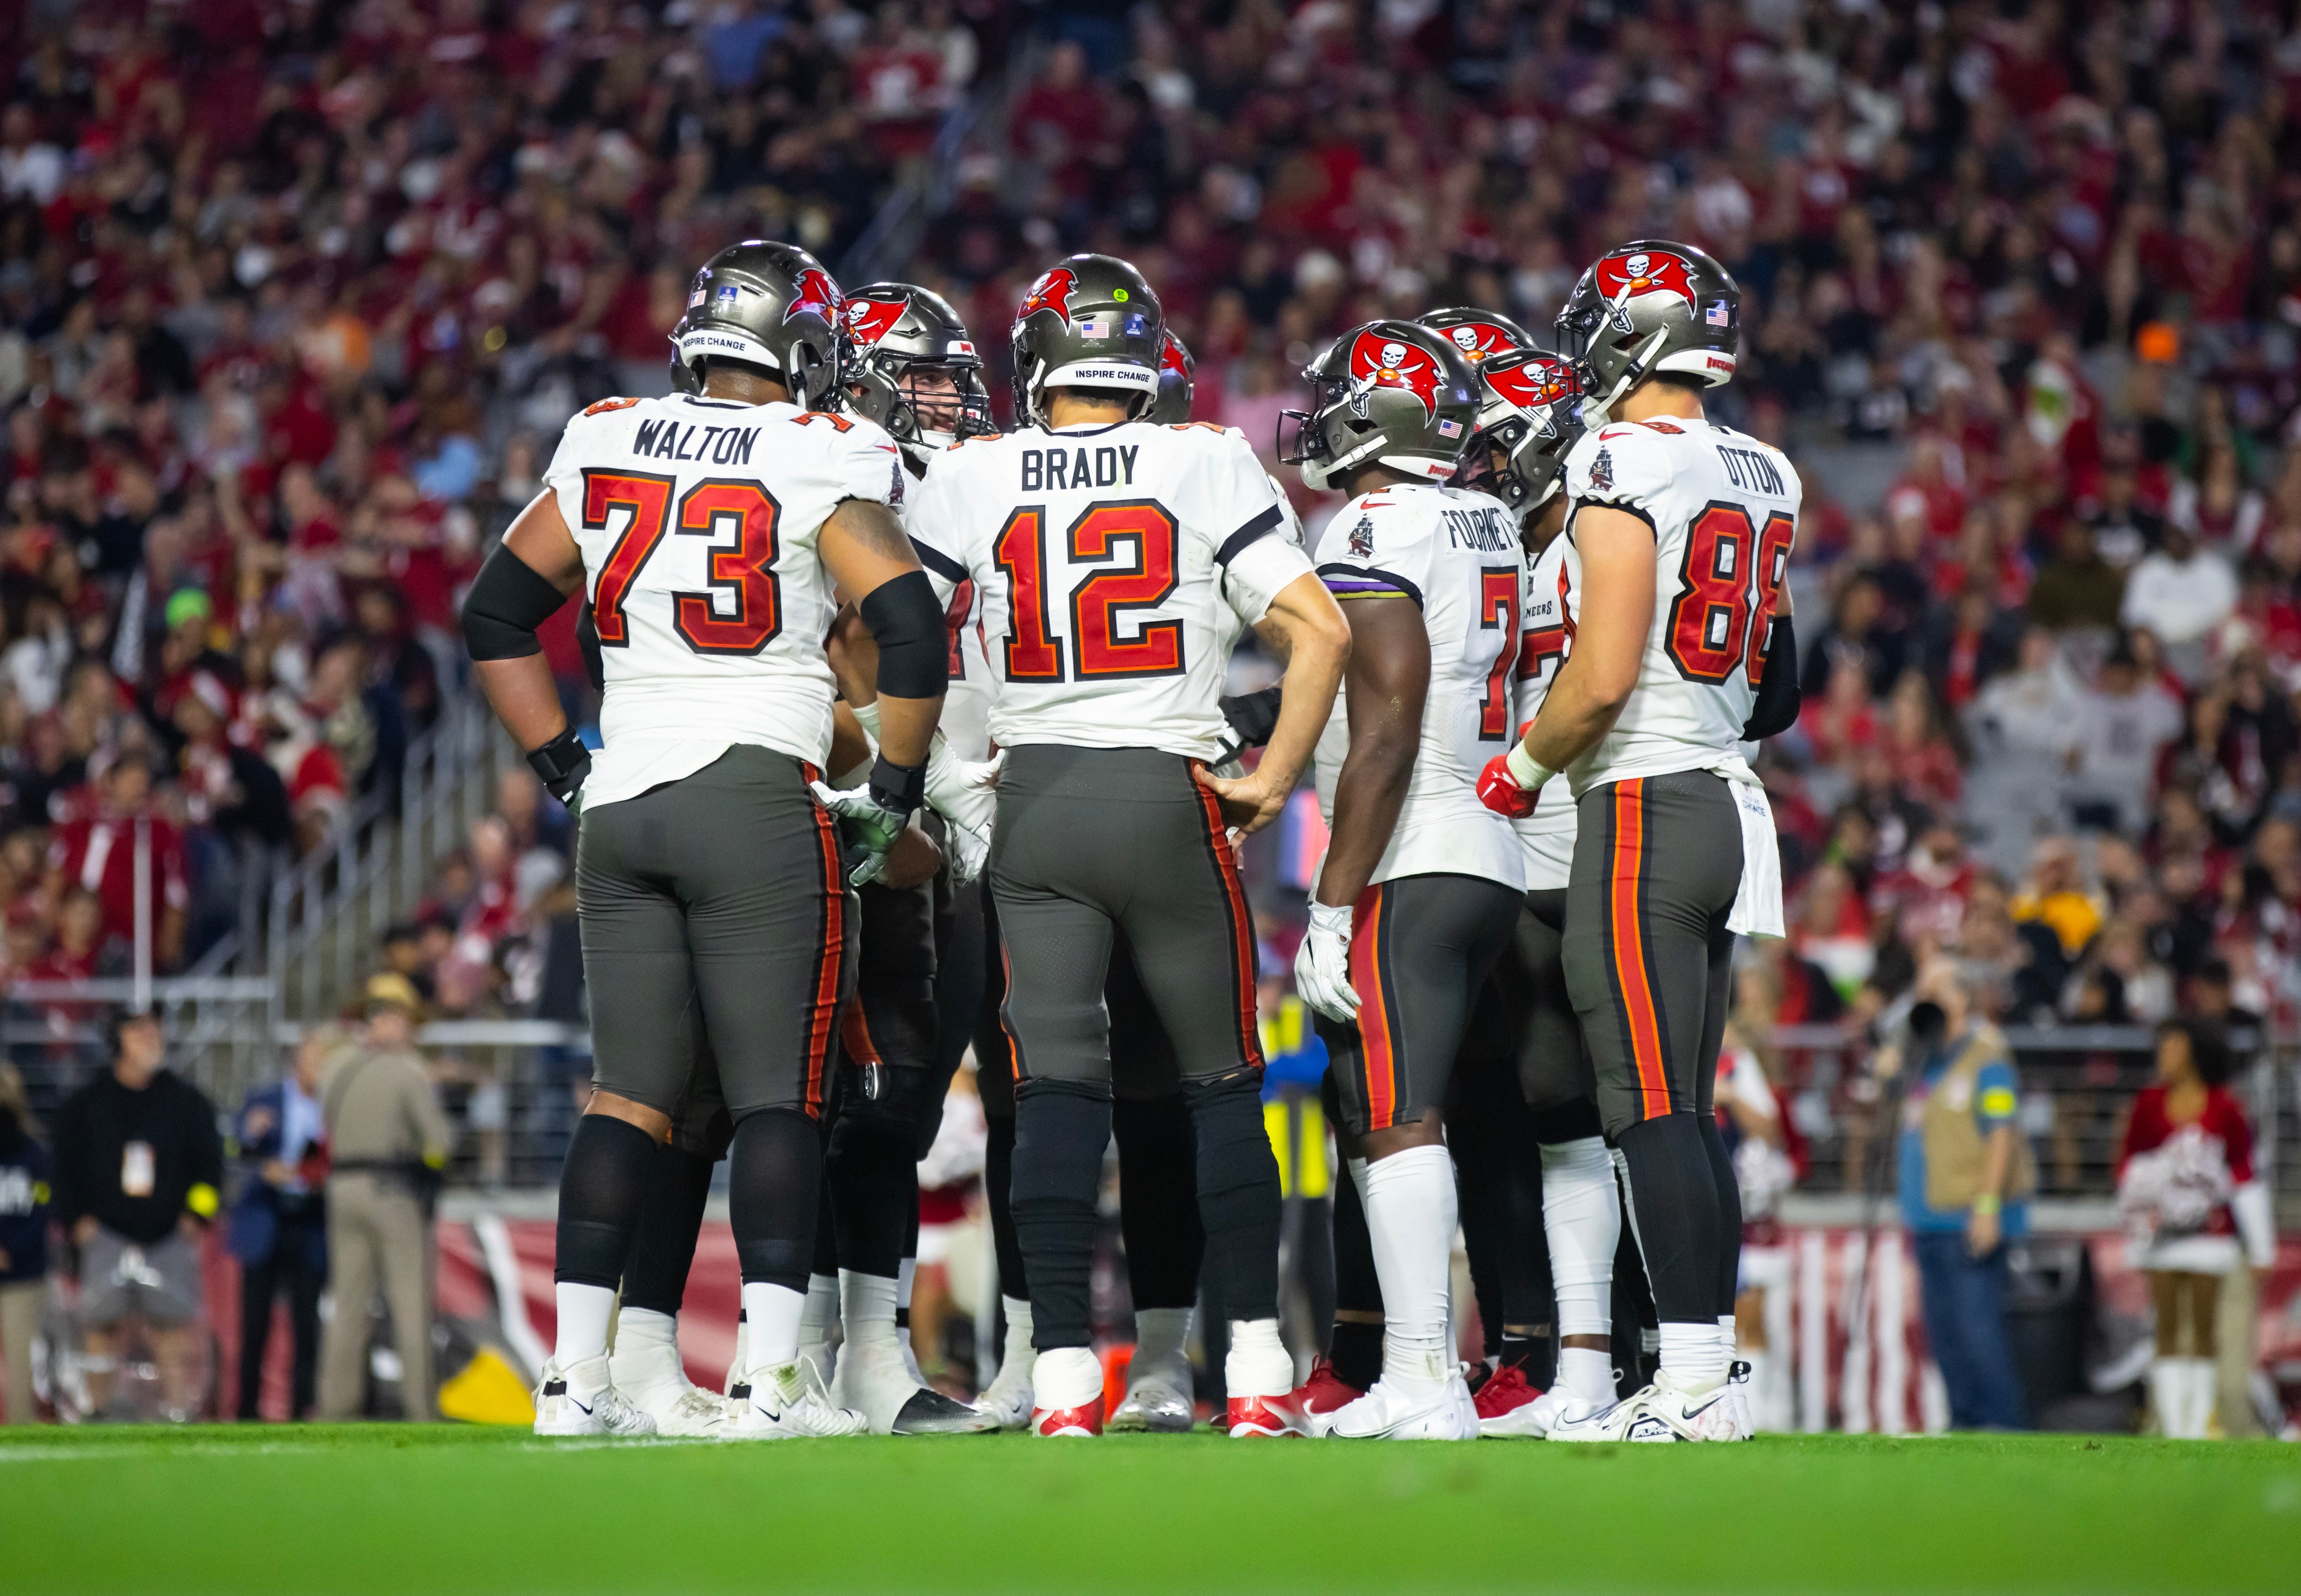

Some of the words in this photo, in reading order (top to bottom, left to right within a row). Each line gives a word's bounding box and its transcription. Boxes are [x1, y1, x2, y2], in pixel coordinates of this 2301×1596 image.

[682, 337, 705, 349] INSPIRE
[708, 338, 746, 351] CHANGE
[1076, 370, 1115, 378] INSPIRE
[1118, 371, 1150, 383] CHANGE
[633, 418, 763, 465] WALTON
[1021, 445, 1139, 492] BRADY
[1716, 444, 1785, 496] OTTON
[580, 467, 782, 656] 73
[992, 498, 1186, 683] 12
[1525, 601, 1552, 619] NEERS
[1663, 499, 1794, 692] 88
[1478, 564, 1520, 742] 7
[1637, 1426, 1671, 1437] ALPHA
